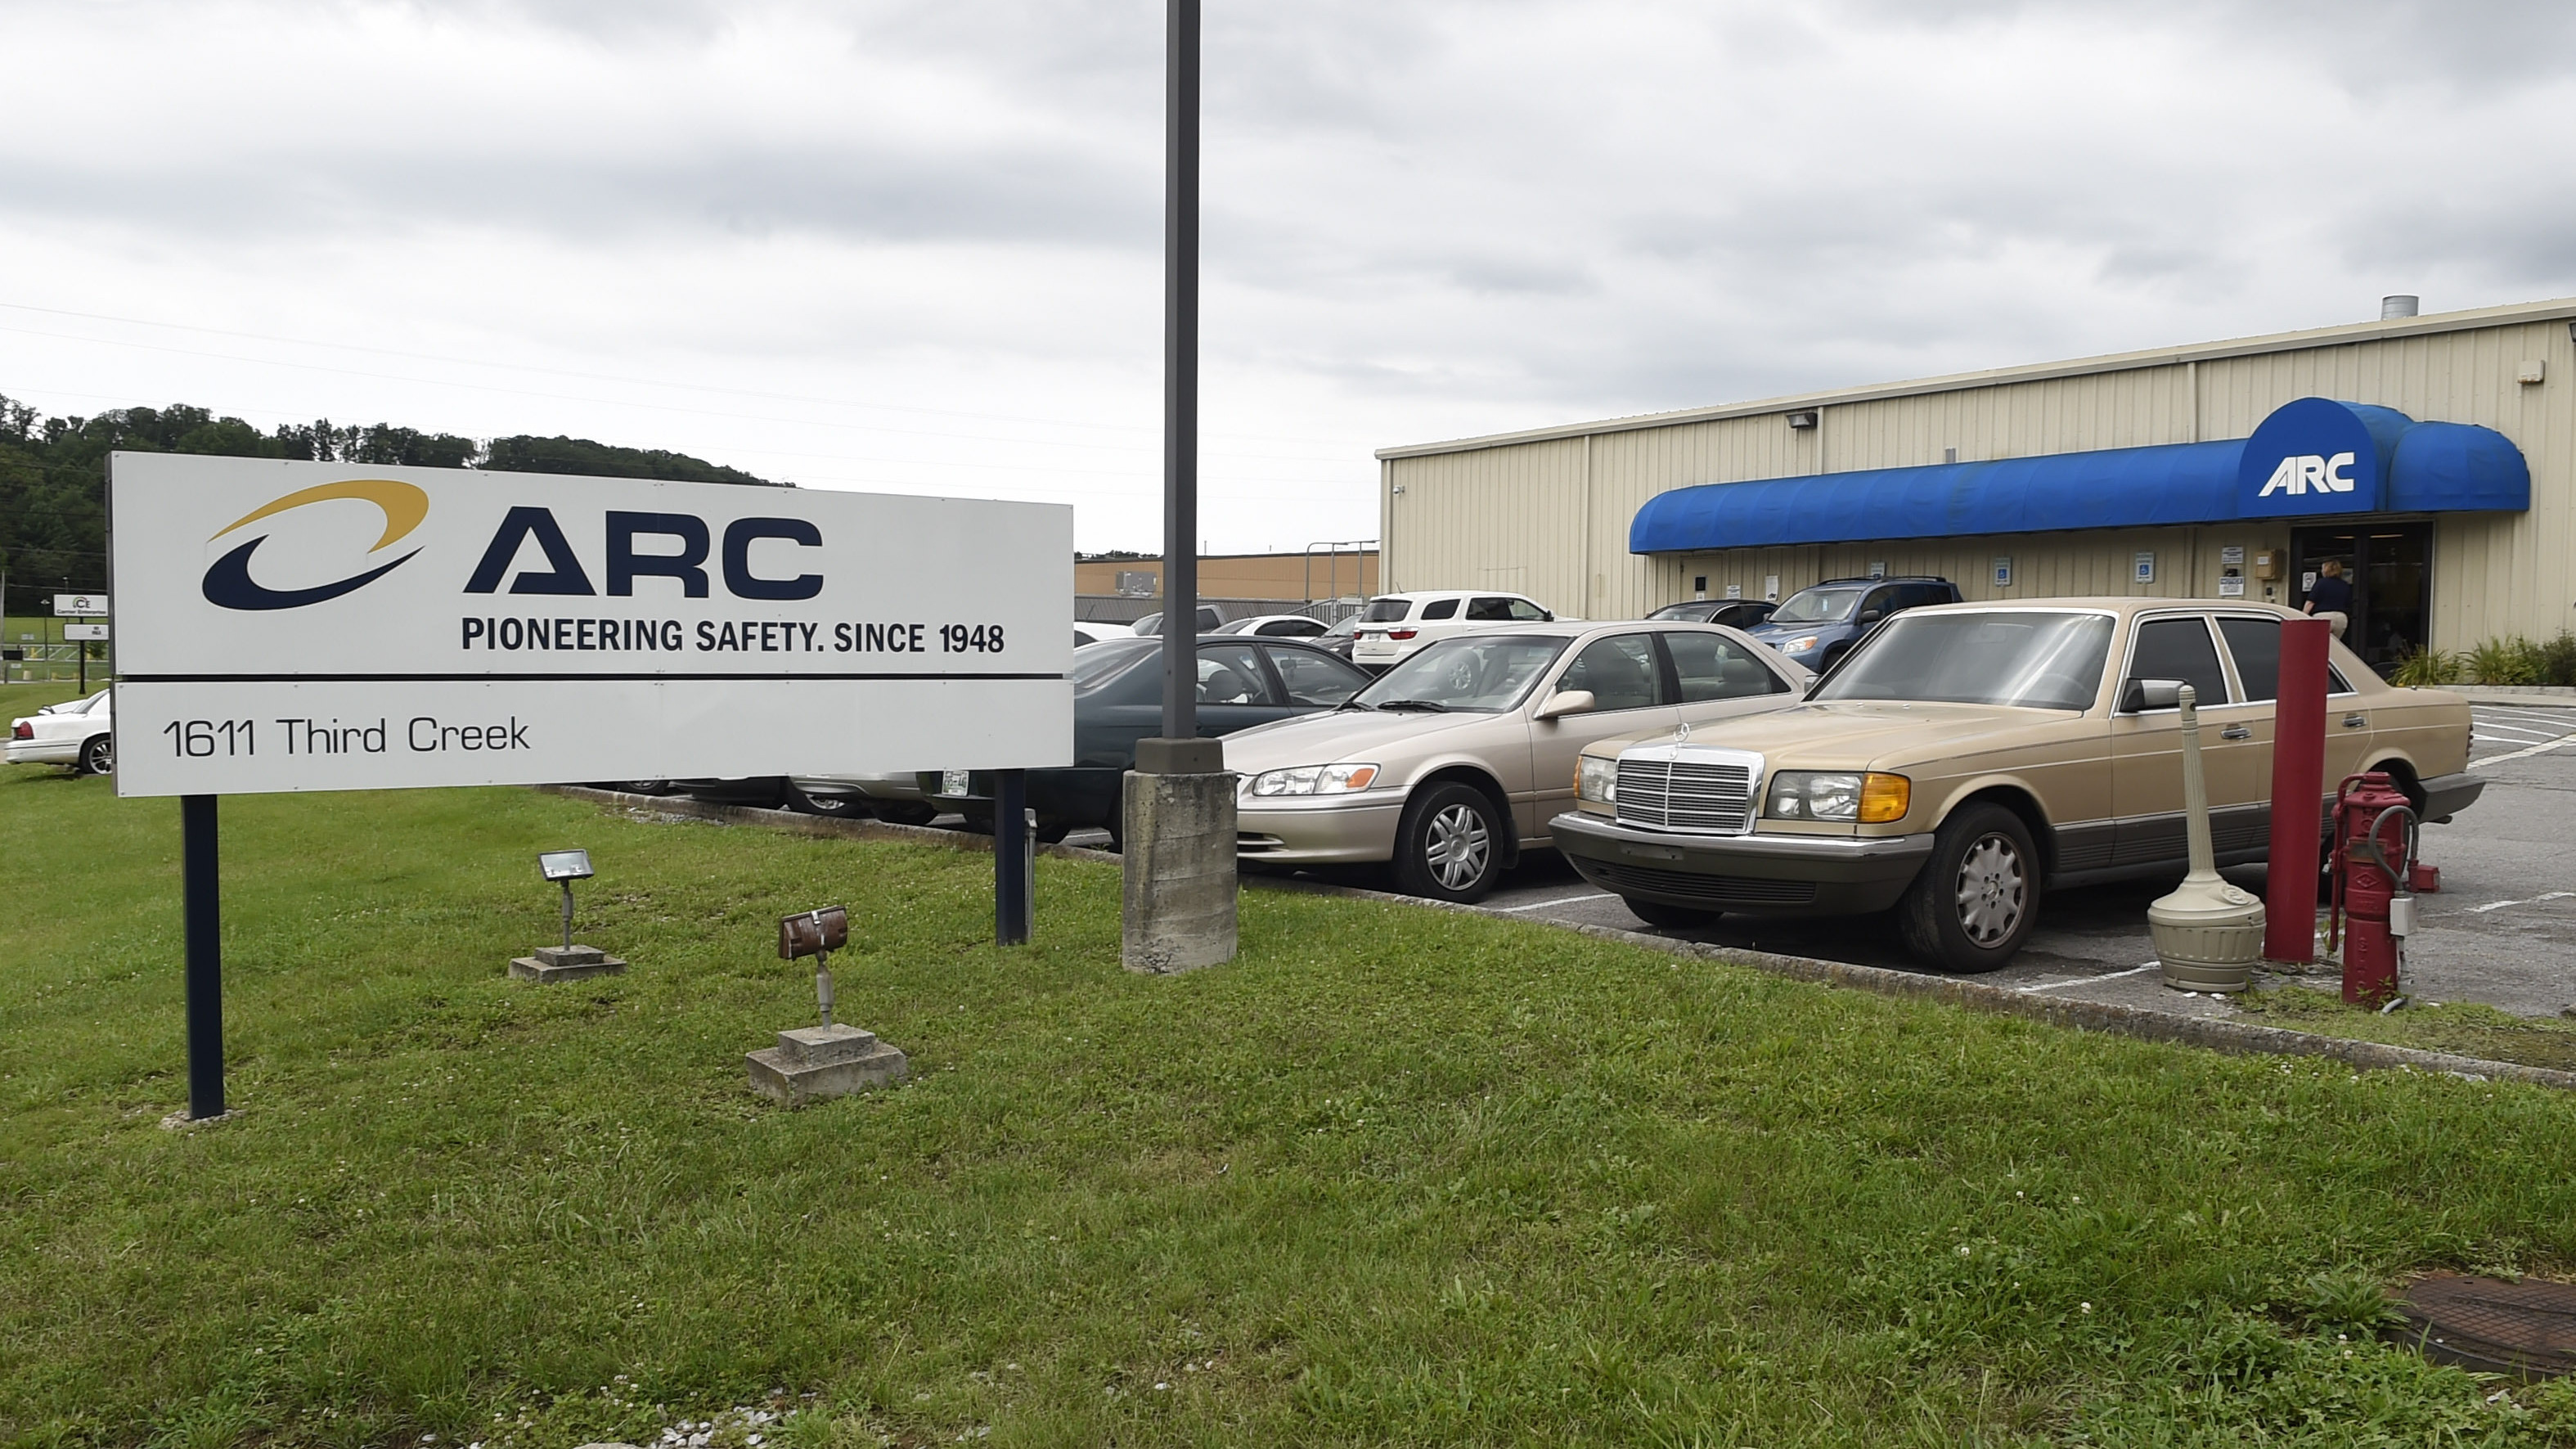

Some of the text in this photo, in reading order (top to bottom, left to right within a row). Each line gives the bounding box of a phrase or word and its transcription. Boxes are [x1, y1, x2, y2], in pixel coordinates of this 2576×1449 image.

[2258, 452, 2355, 497] ARC
[462, 506, 825, 602] ARC
[462, 616, 1005, 654] PIONEERING SAFETY. SINCE 1948
[162, 715, 532, 758] 1611 Third Creek
